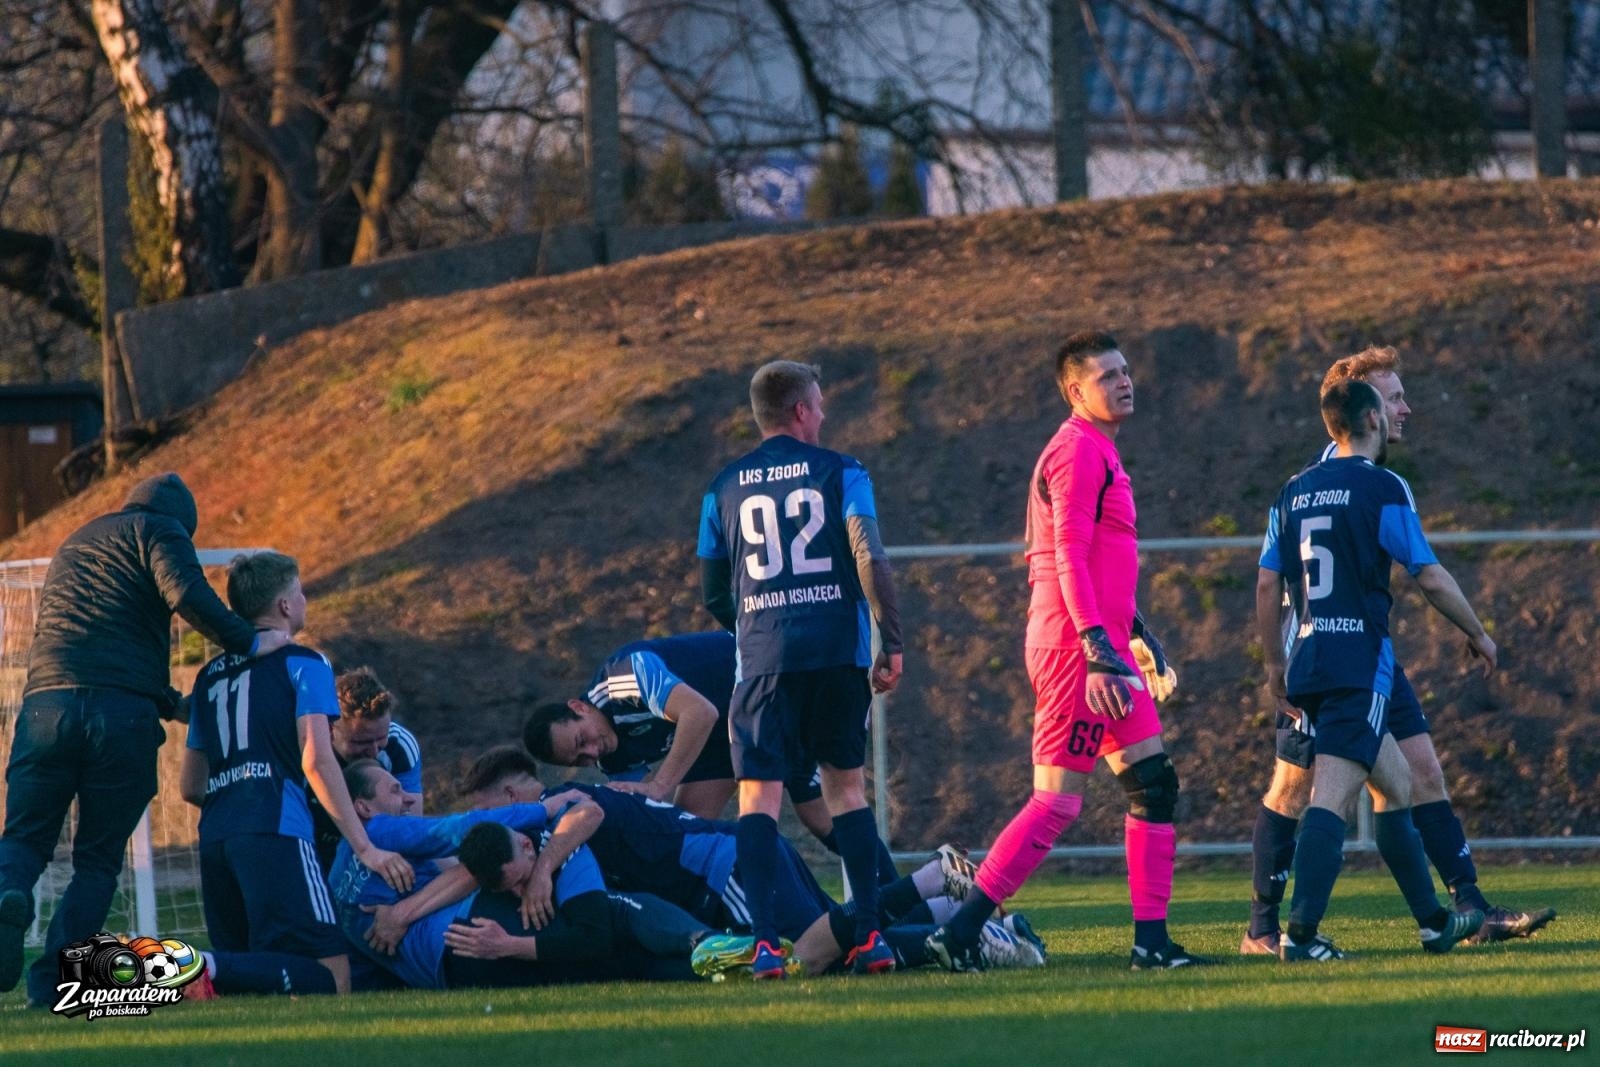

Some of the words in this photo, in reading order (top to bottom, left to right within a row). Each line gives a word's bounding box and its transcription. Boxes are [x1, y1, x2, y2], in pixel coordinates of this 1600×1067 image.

[739, 468, 763, 486] LKS
[766, 461, 810, 482] ZGODA
[1291, 493, 1311, 512] LKS
[1312, 489, 1351, 508] ZGODA
[739, 487, 832, 580] 92
[1300, 515, 1335, 600] 5
[743, 589, 787, 614] ZAWADA
[789, 583, 842, 606] KSIĄŻĘCA
[207, 669, 251, 759] 11
[1068, 720, 1104, 757] 69
